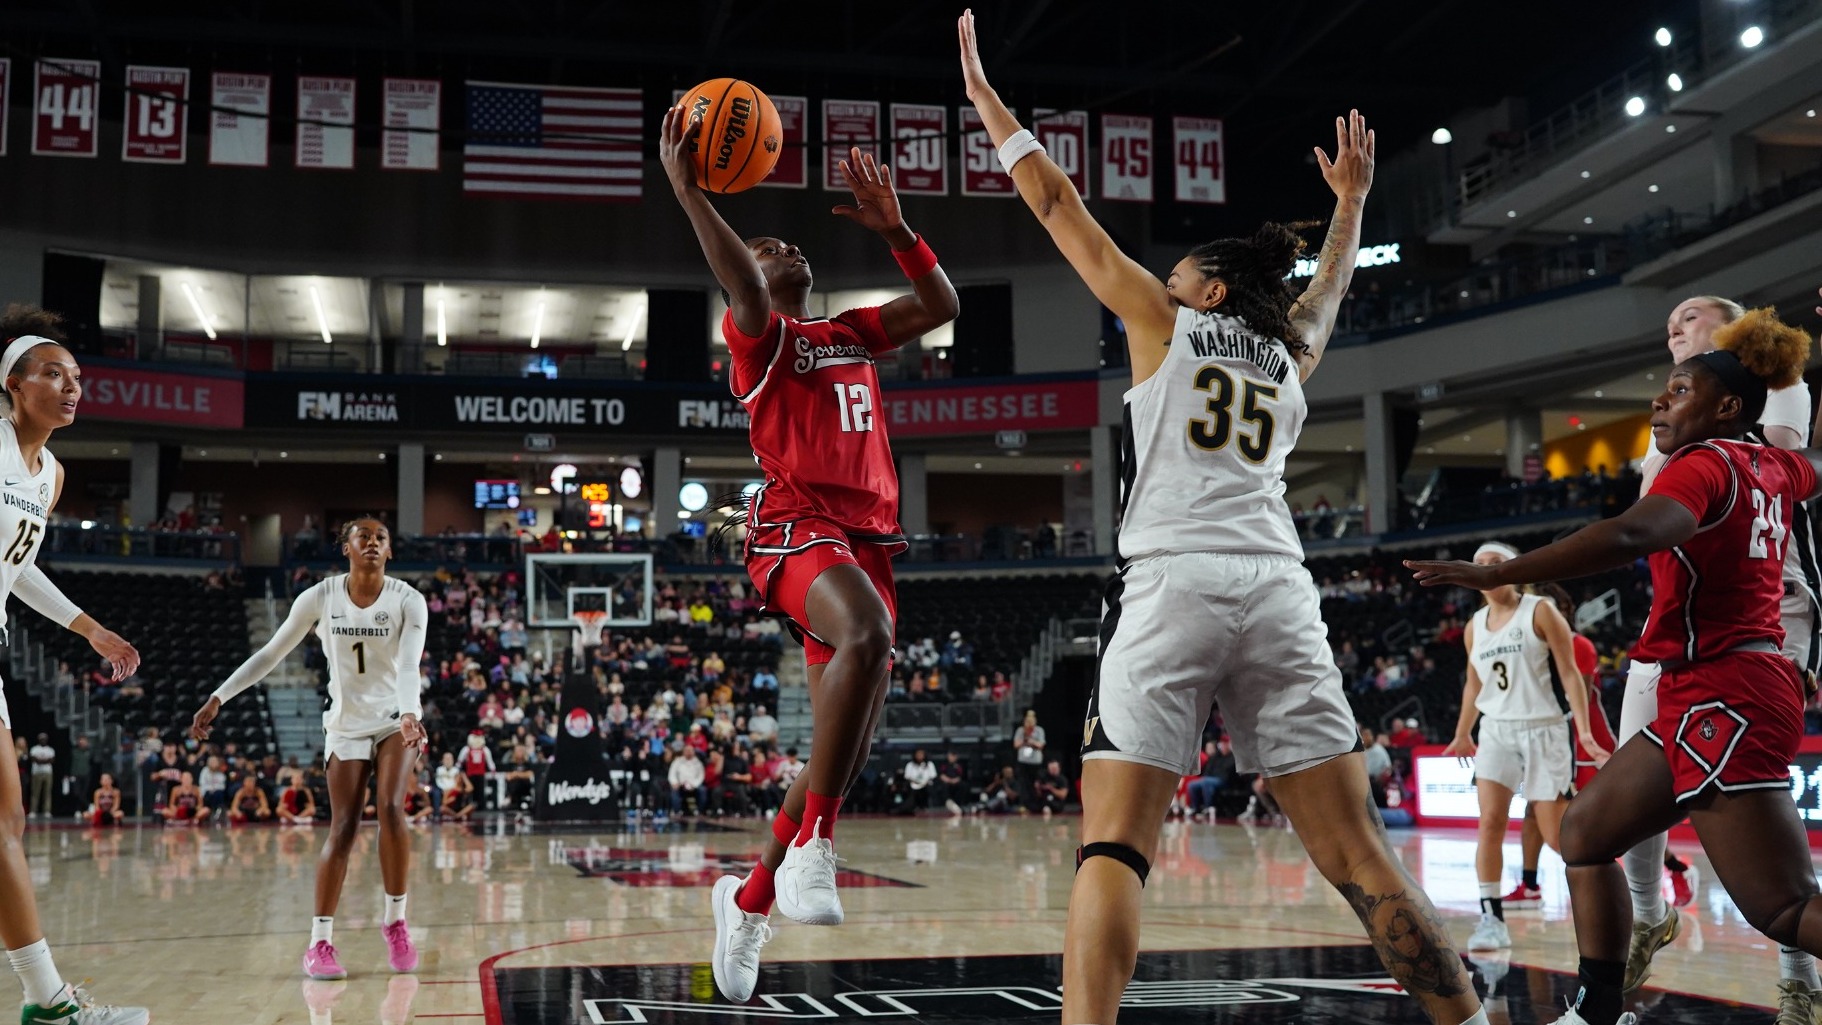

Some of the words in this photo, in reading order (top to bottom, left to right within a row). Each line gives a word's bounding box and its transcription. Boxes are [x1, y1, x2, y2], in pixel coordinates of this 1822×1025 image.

[40, 83, 92, 131] 44
[137, 91, 177, 139] 13
[713, 96, 753, 171] Wilson
[897, 127, 940, 173] 30
[1107, 138, 1148, 178] 45
[1179, 140, 1220, 180] 44
[1187, 330, 1289, 385] WASHINGTON
[342, 404, 399, 421] ARENA
[344, 392, 397, 403] BANK
[454, 395, 587, 424] WELCOME
[588, 398, 626, 425] TO
[833, 383, 873, 432] 12
[1187, 364, 1278, 464] 35
[720, 412, 750, 429] ARE
[3, 518, 41, 566] 15
[1748, 488, 1787, 561] 24
[331, 626, 389, 637] VANDERBILT
[352, 641, 366, 675] 1
[1492, 661, 1508, 691] 3
[548, 777, 610, 806] Wendy's
